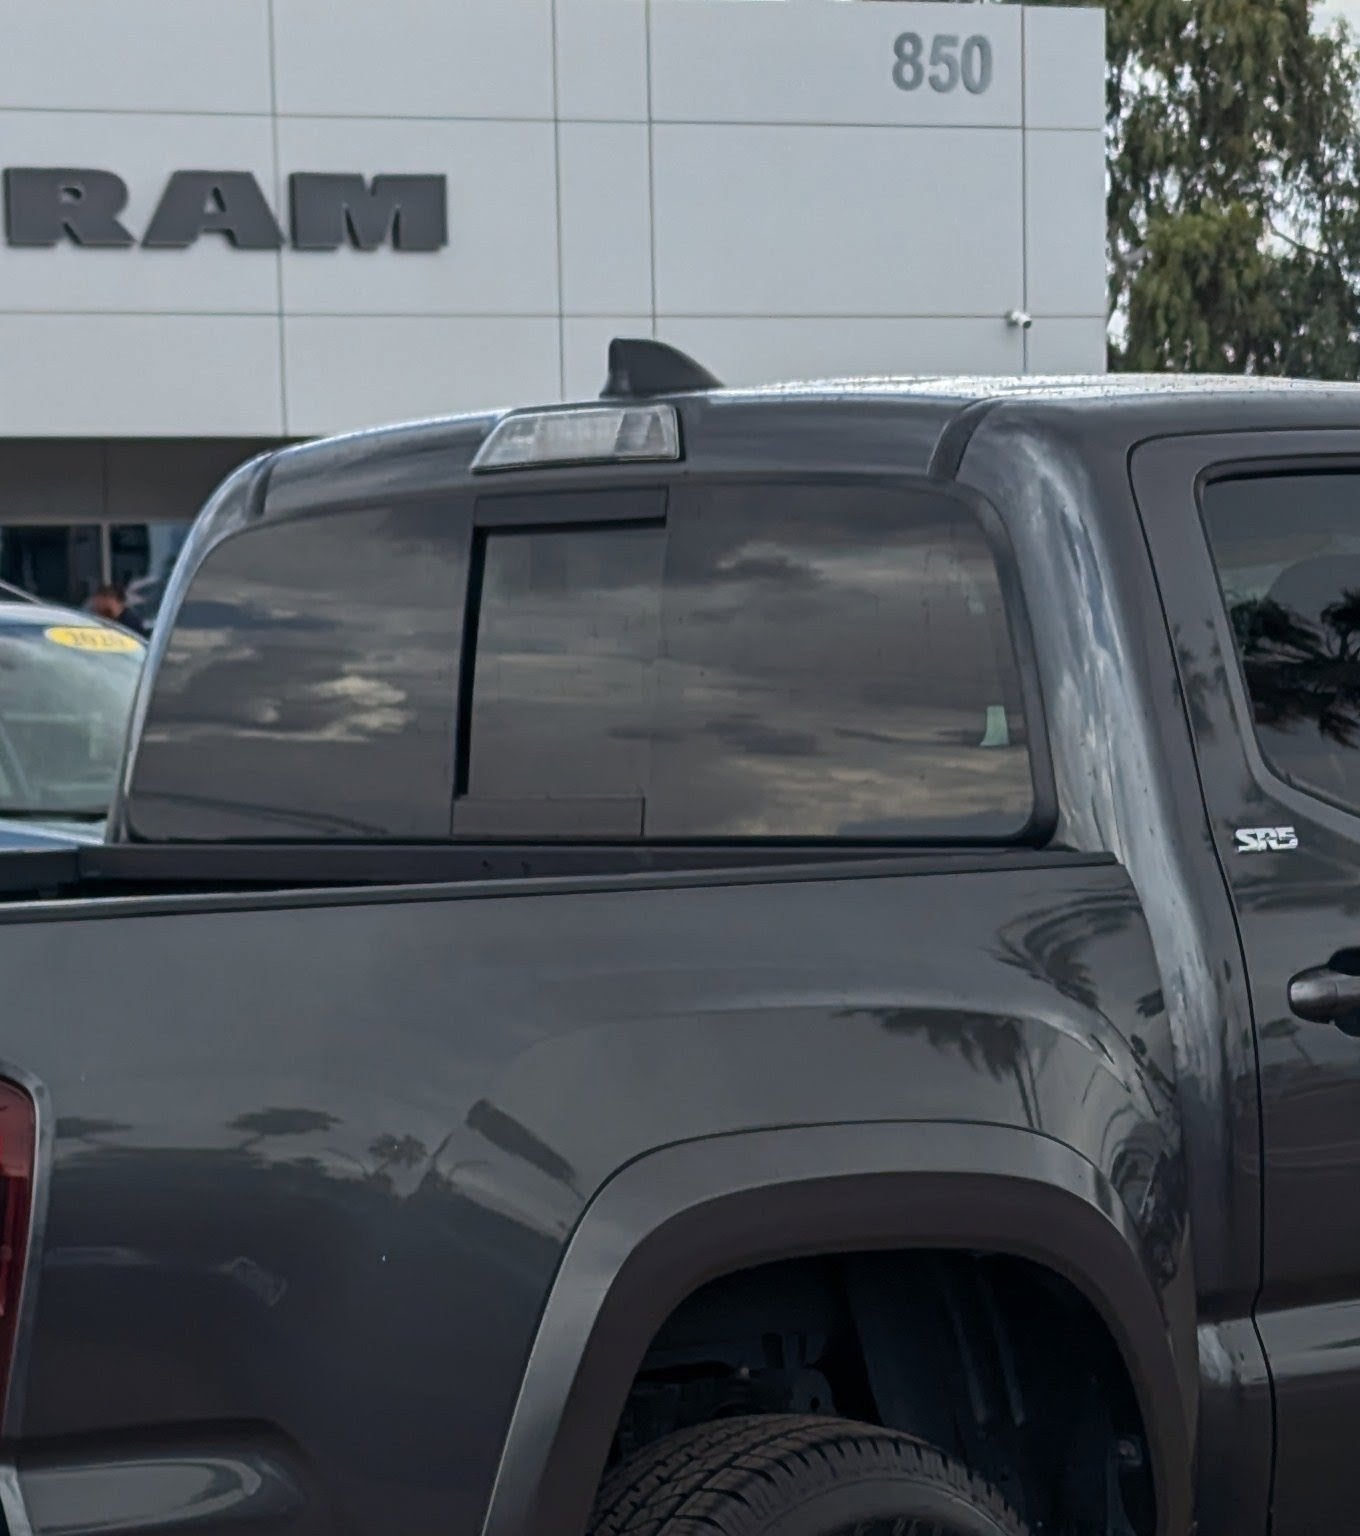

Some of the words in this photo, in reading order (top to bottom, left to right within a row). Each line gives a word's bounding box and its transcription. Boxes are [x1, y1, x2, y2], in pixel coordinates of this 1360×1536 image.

[892, 32, 992, 94] 850
[3, 167, 447, 251] RAM
[1235, 826, 1299, 853] SR5
